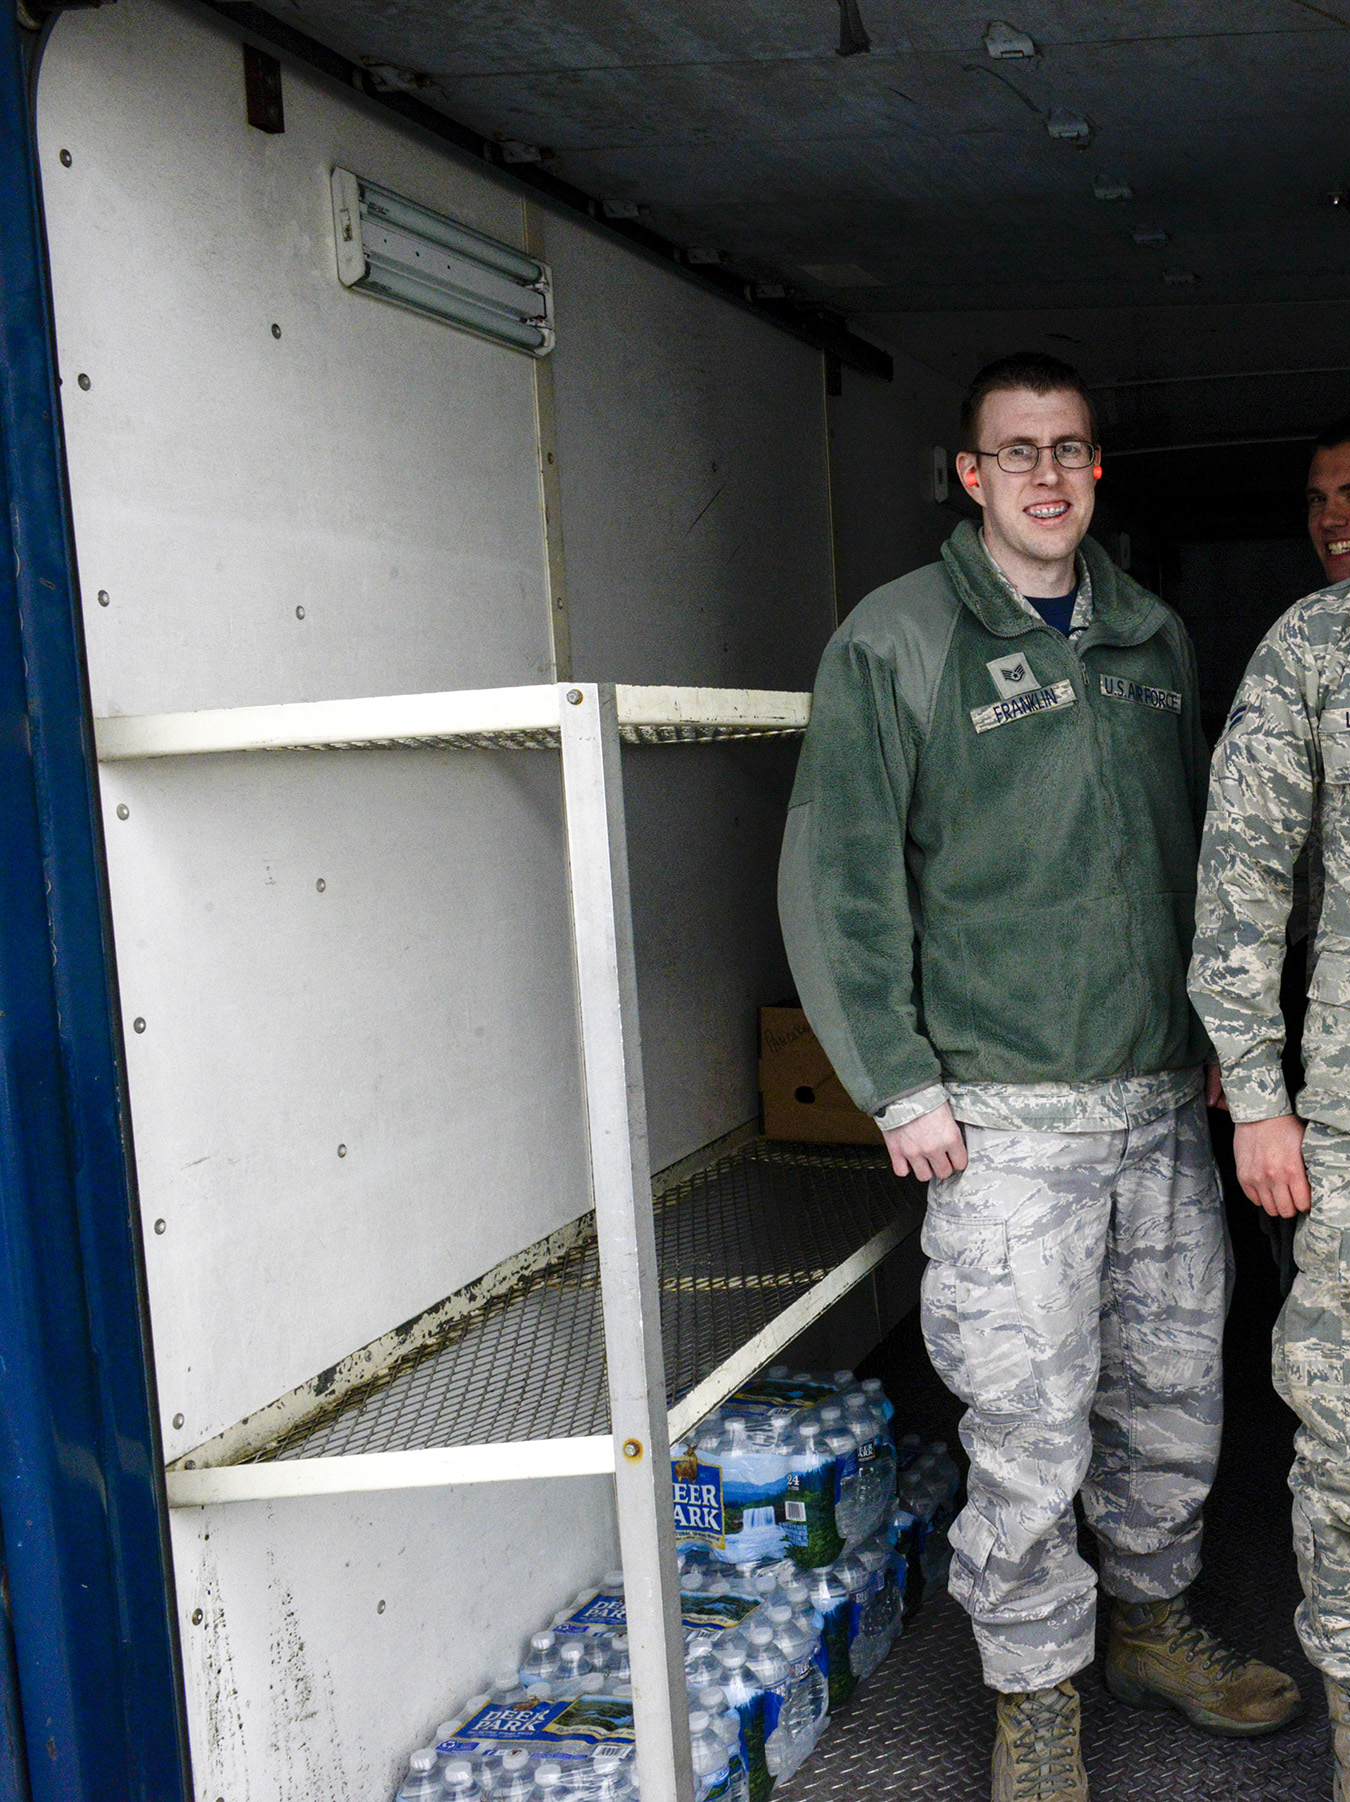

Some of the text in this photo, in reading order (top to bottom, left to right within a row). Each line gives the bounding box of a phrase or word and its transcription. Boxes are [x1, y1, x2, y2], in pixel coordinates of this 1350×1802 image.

[992, 687, 1058, 724] FRANKLIN
[1105, 677, 1179, 711] U.S. AIR FORCE
[786, 1474, 800, 1486] 24
[472, 1719, 536, 1731] PARK
